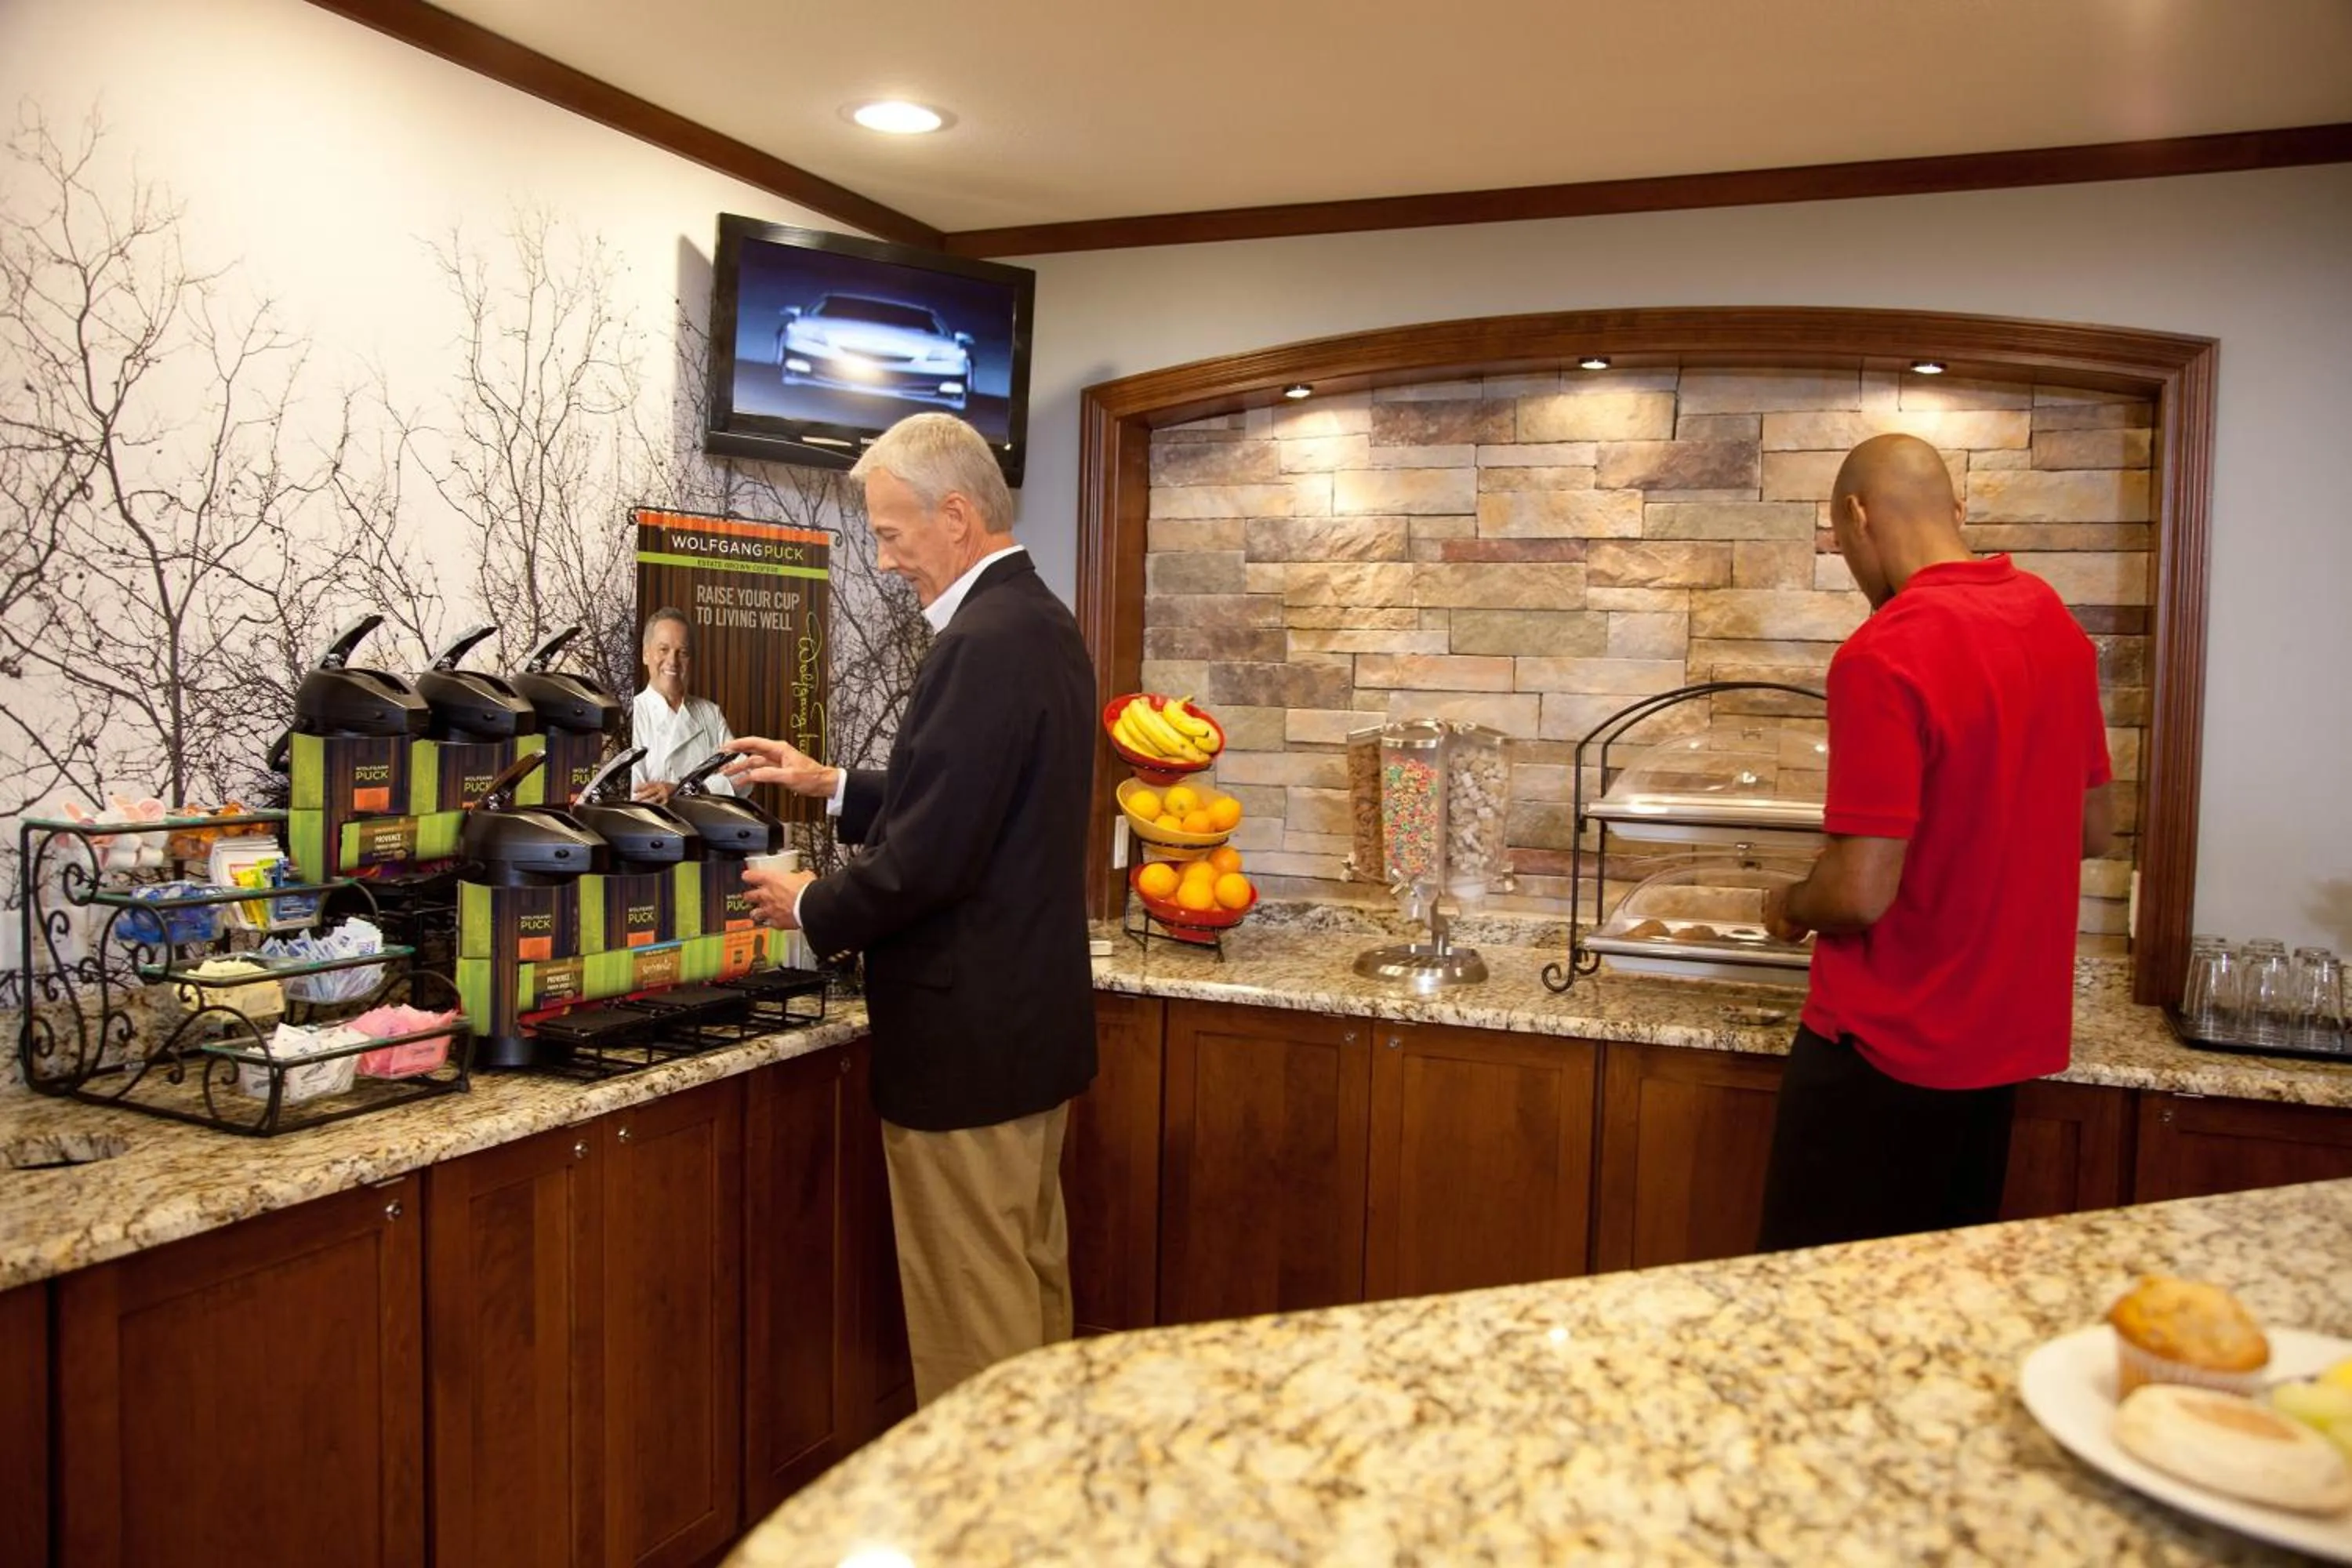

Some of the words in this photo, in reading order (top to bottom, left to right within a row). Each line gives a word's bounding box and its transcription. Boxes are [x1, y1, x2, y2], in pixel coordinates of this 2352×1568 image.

[697, 584, 735, 605] RAISE
[737, 589, 771, 608] YOUR
[774, 592, 800, 610] CUP
[695, 606, 713, 625] TO
[716, 608, 757, 628] LIVING
[760, 612, 793, 631] WELL
[355, 770, 389, 781] PUCK
[628, 912, 654, 924] PUCK
[520, 920, 551, 931] PUCK
